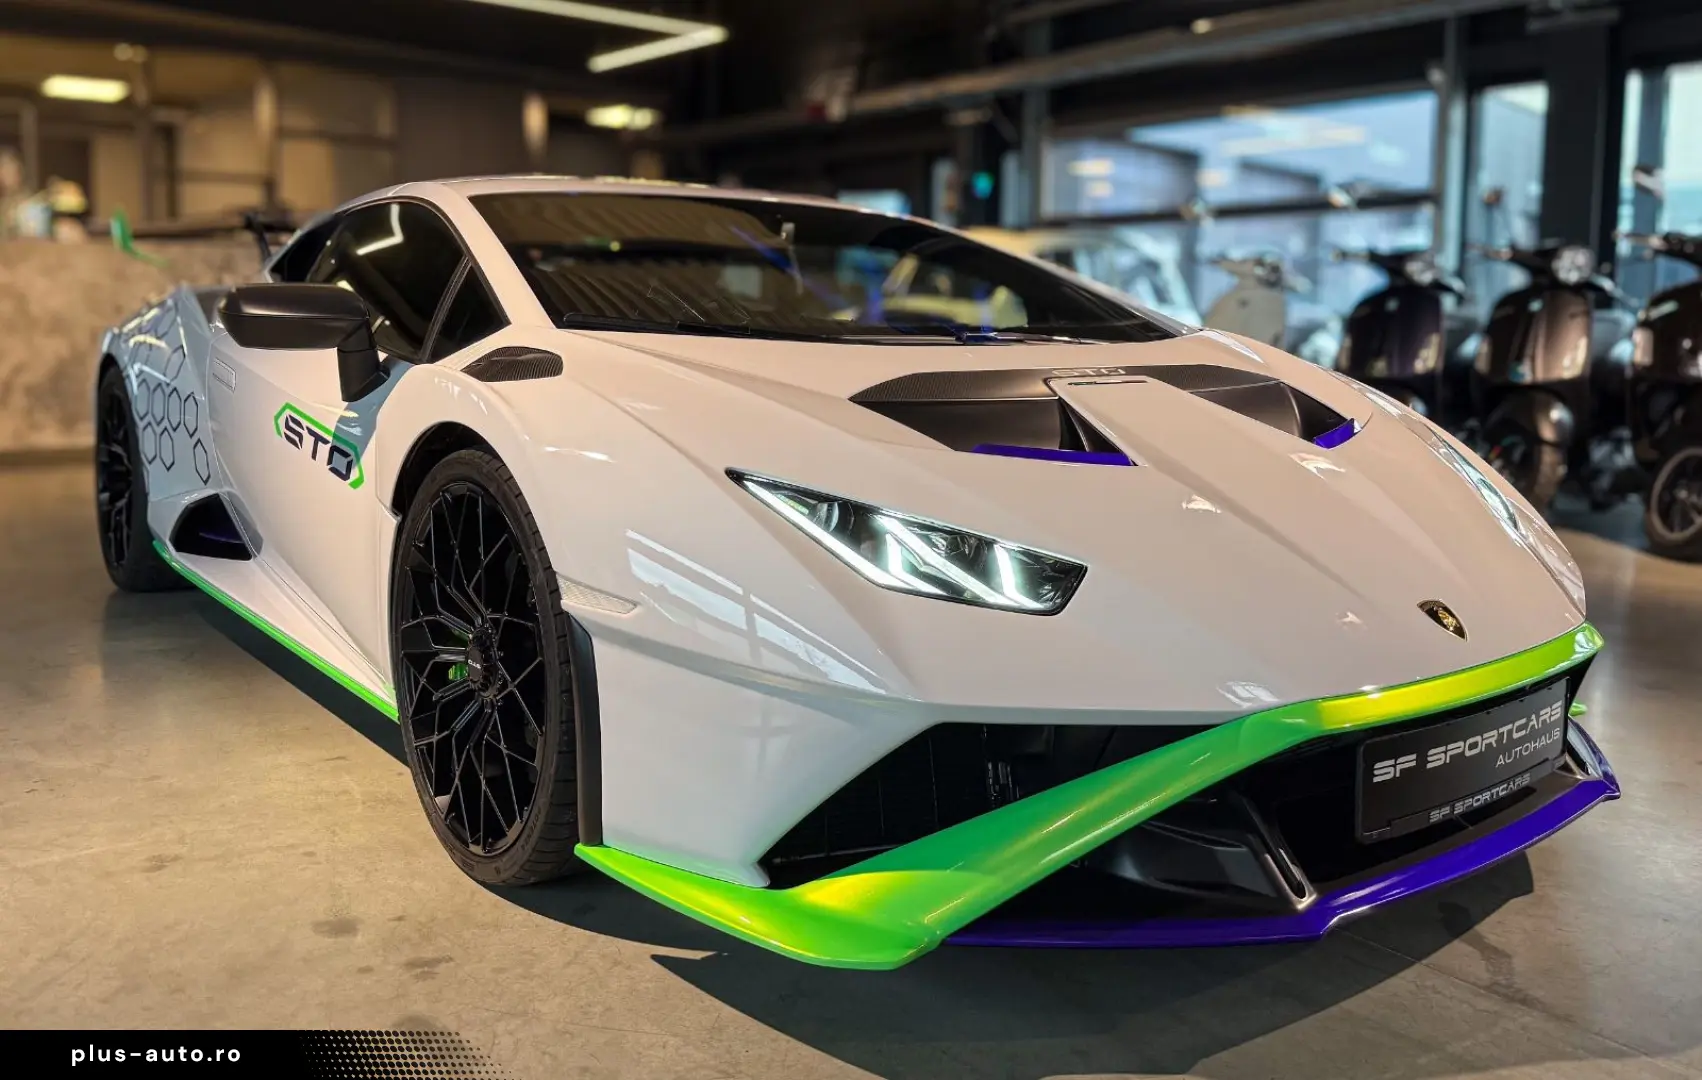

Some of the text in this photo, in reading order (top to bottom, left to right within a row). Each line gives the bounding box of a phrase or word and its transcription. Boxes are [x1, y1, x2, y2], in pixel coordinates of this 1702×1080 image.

[283, 413, 354, 481] STO
[1373, 700, 1562, 783] SF SPORTCARS
[1495, 727, 1560, 768] AUTOHAUS
[1429, 773, 1531, 823] SF SPORTCARS
